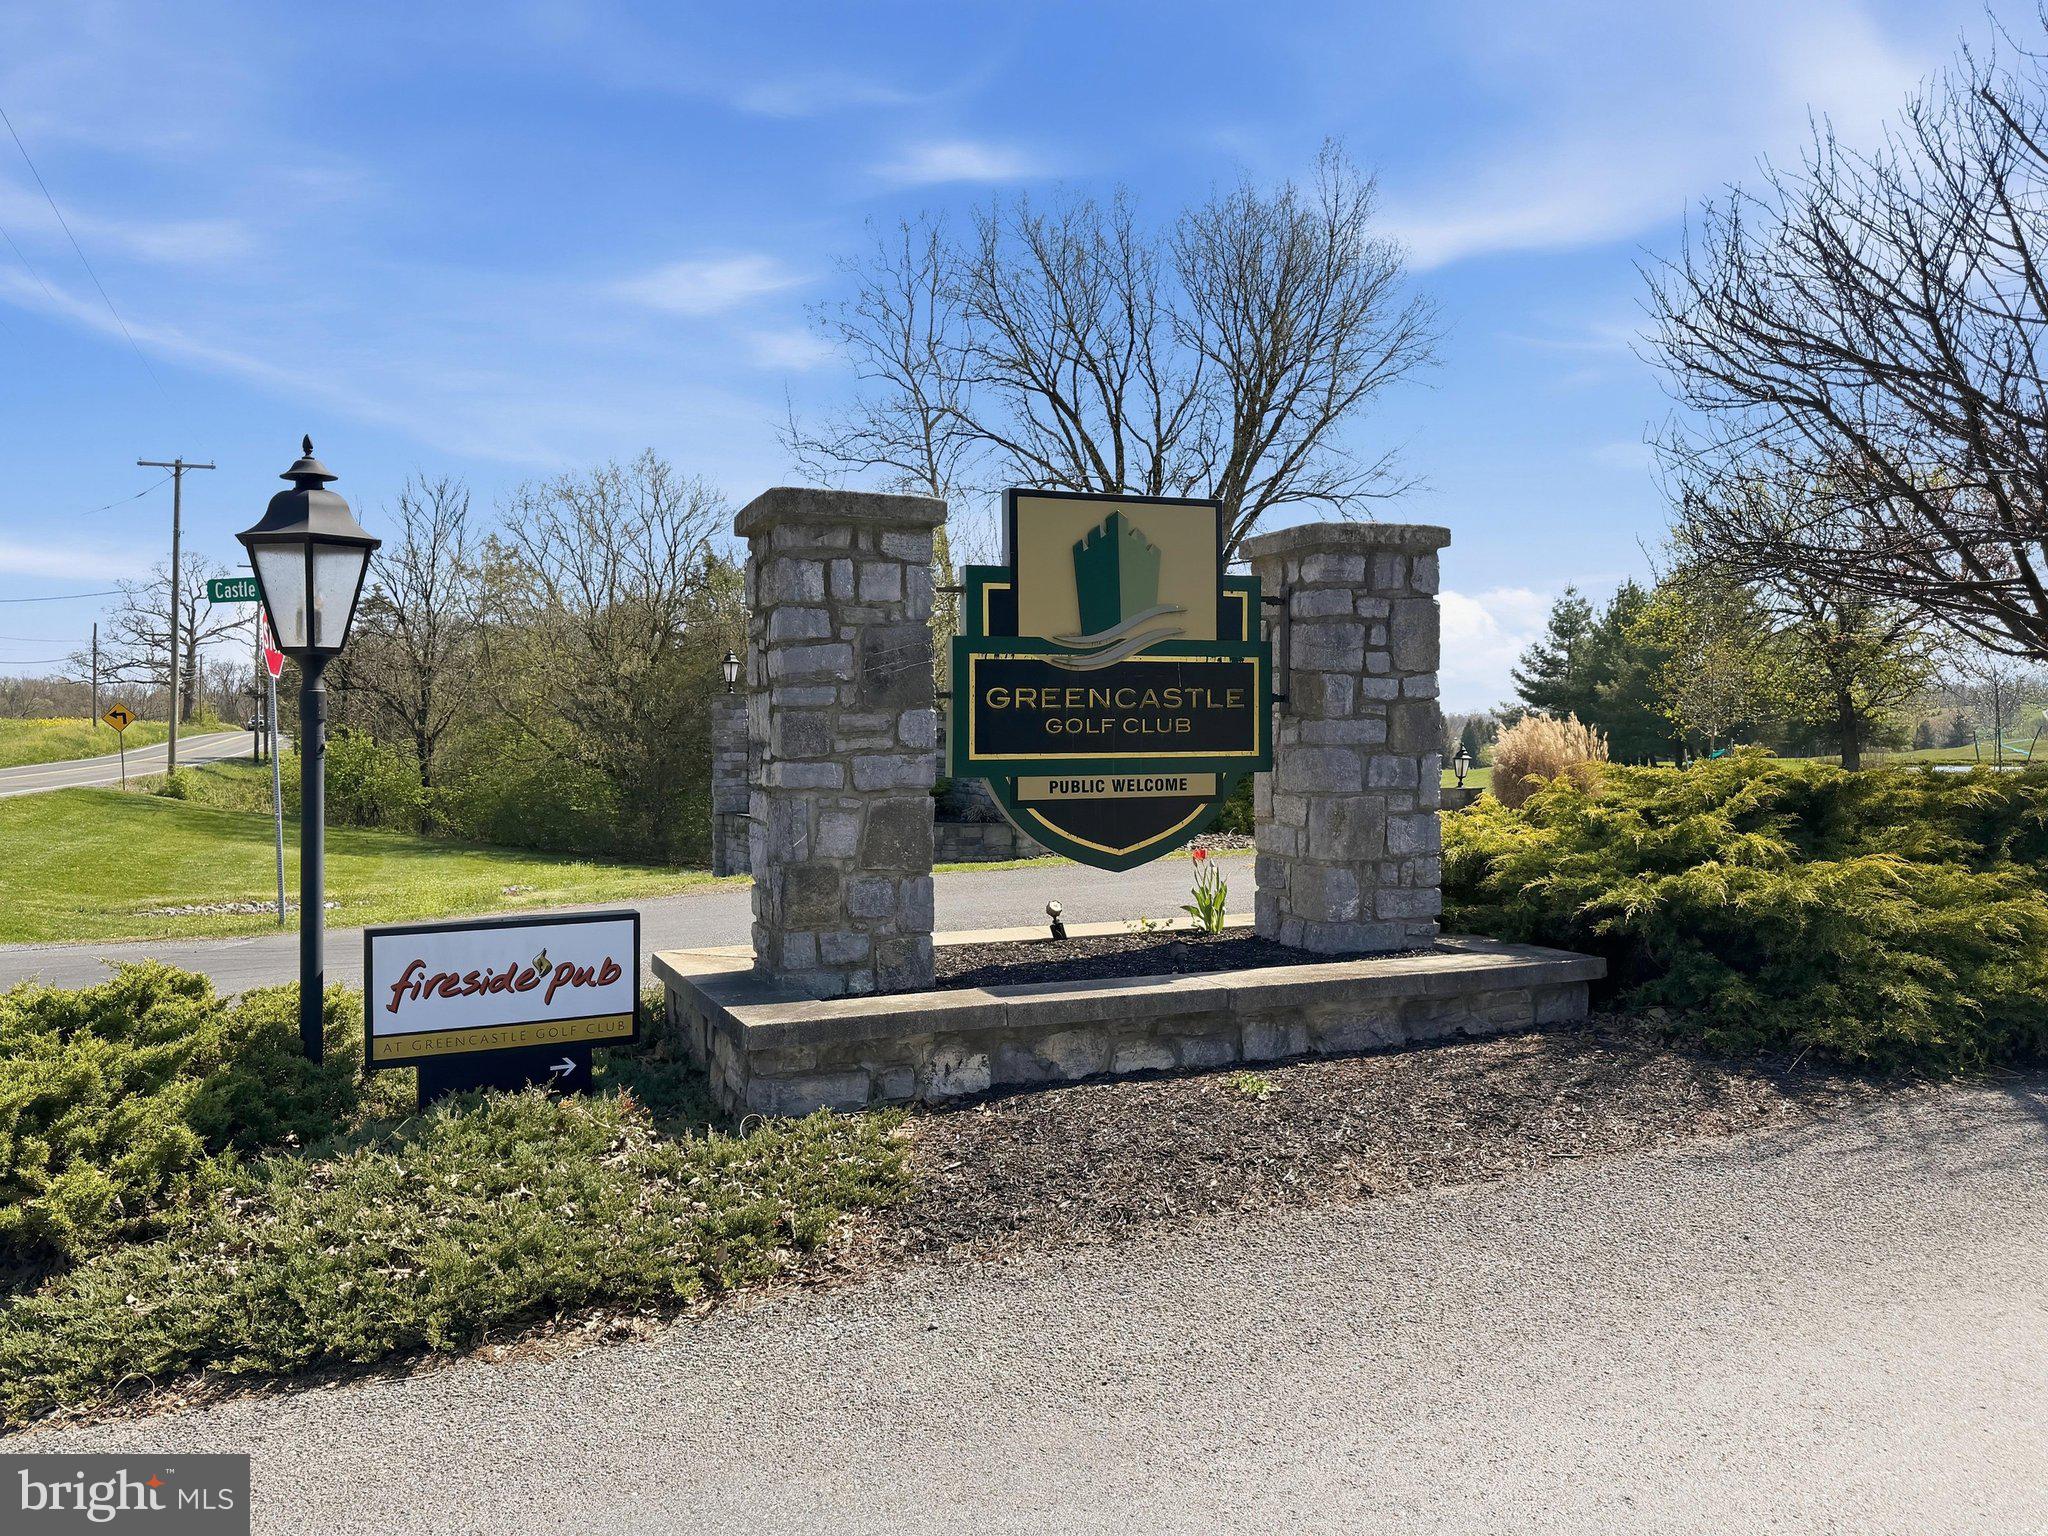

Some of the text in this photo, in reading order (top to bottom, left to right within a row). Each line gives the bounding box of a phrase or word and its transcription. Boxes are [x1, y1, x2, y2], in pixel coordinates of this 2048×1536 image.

[215, 581, 256, 599] Castle
[985, 687, 1245, 710] GREENCASTLE
[1045, 717, 1191, 734] GOLF CLUB
[1049, 777, 1188, 794] PUBLIC WELCOME
[385, 956, 623, 1014] fireside pub
[383, 1020, 625, 1053] AT GREENCASTLE GOLF CLUB
